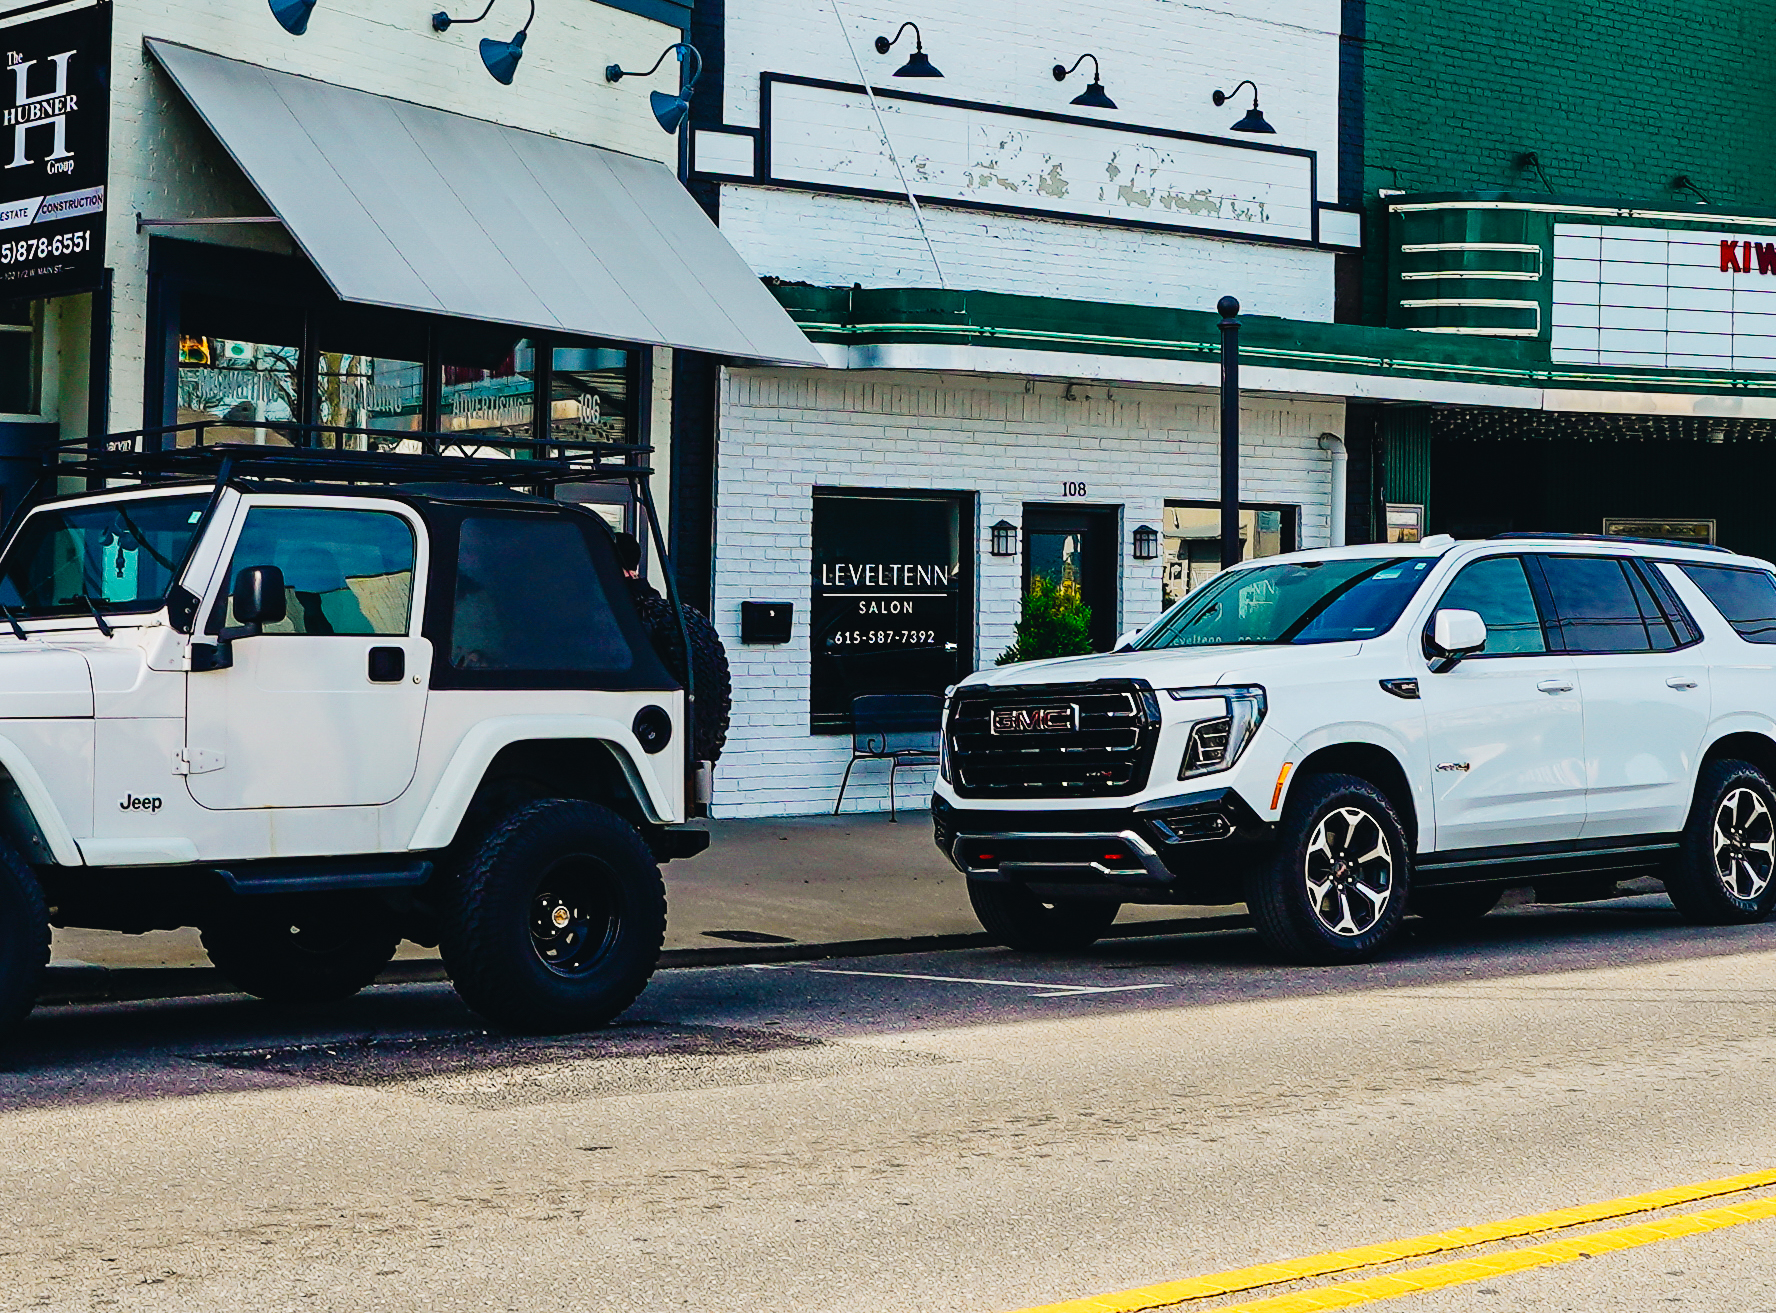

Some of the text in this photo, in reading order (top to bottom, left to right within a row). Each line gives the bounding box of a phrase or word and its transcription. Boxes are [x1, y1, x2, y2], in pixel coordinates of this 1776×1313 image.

[7, 51, 23, 65] The
[3, 94, 78, 126] HUBNER
[47, 160, 74, 175] Group
[41, 193, 103, 215] CONSTRUCTION
[340, 382, 402, 414] BRANDING
[452, 392, 525, 423] ADVERTISING
[579, 393, 600, 424] 106
[106, 439, 132, 453] arvin
[1062, 481, 1087, 497] 108
[822, 564, 948, 586] LEVELTENN
[859, 601, 913, 614] SALON
[834, 631, 935, 644] 615-587-7392
[995, 709, 1071, 731] GMC
[120, 794, 162, 812] Jeep
